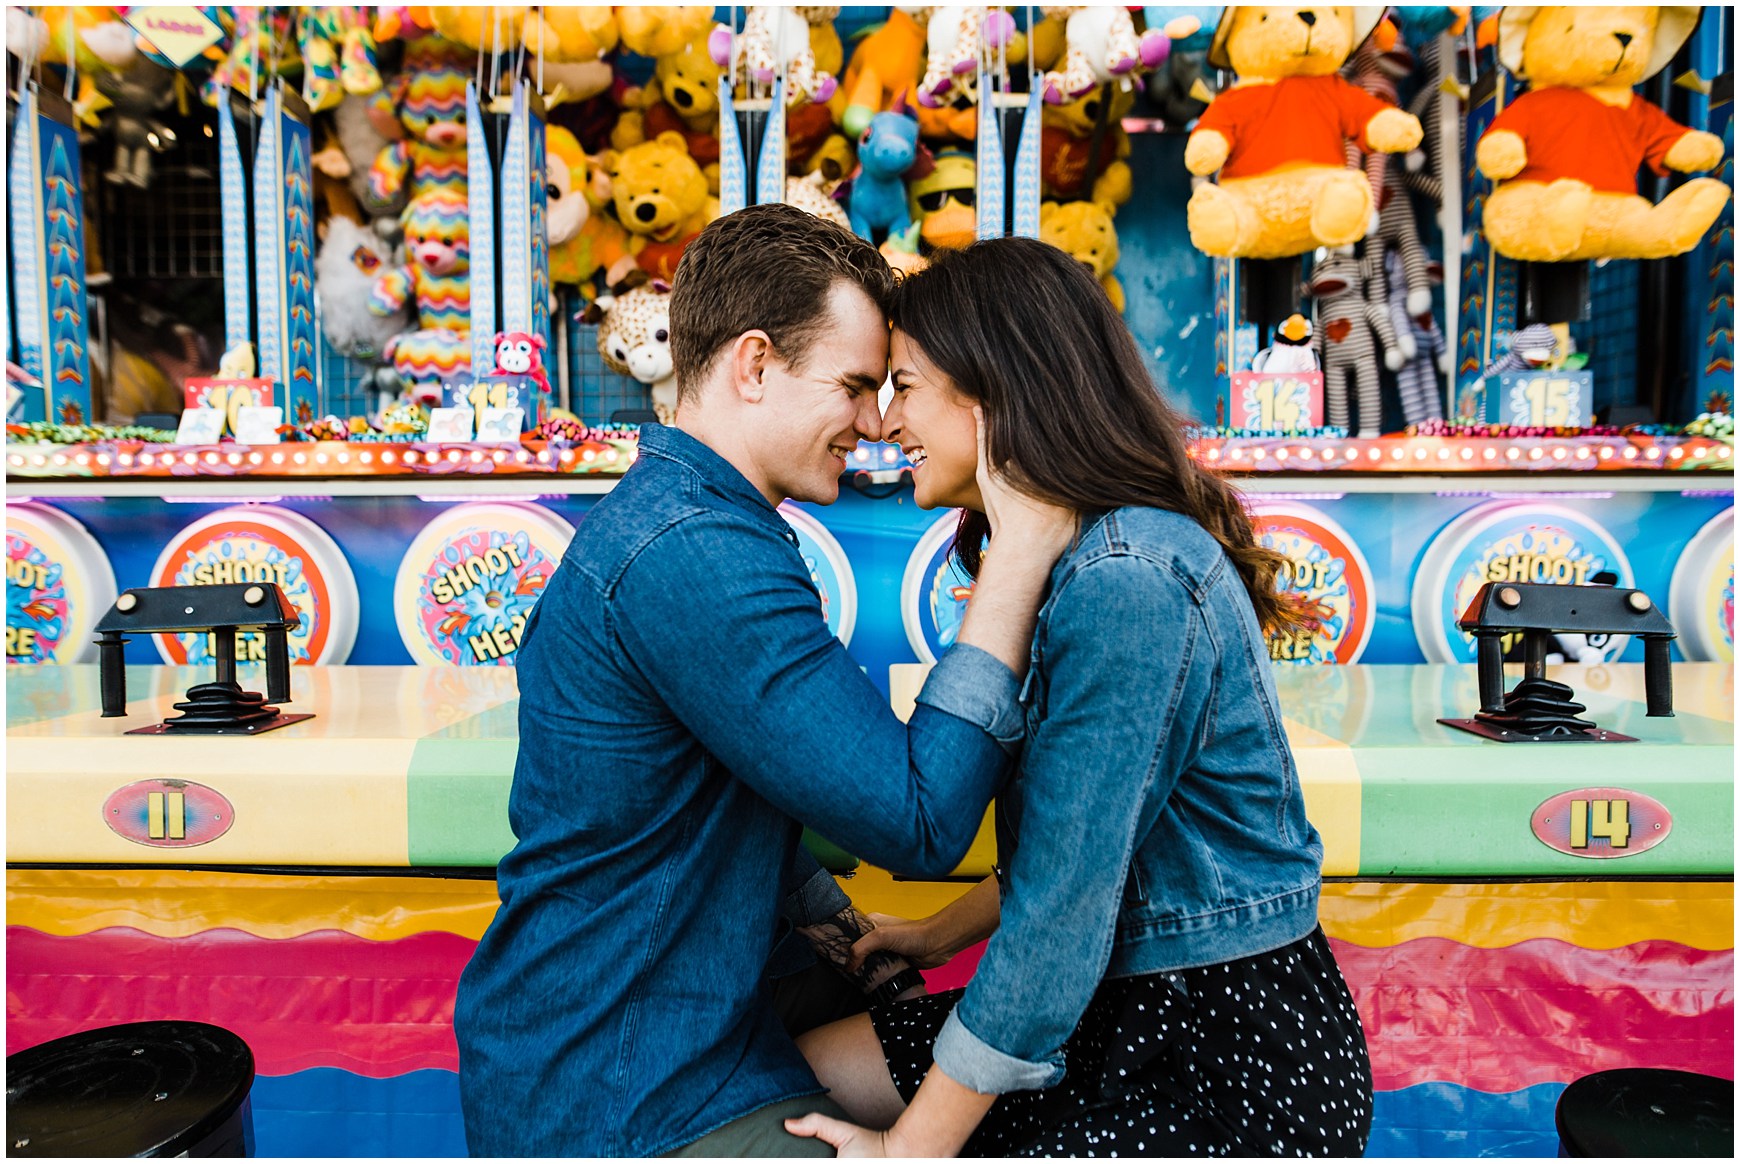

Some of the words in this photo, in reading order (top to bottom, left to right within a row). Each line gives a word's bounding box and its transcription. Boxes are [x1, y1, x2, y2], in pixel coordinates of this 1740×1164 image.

[207, 385, 254, 438] 10
[1255, 380, 1299, 431] 14
[1525, 378, 1569, 427] 15
[195, 560, 288, 590] SHOOT
[432, 543, 522, 605] SHOOT
[1488, 554, 1589, 585] SHOOT
[468, 606, 534, 663] HER
[148, 791, 186, 840] 11
[1569, 799, 1632, 849] 14
